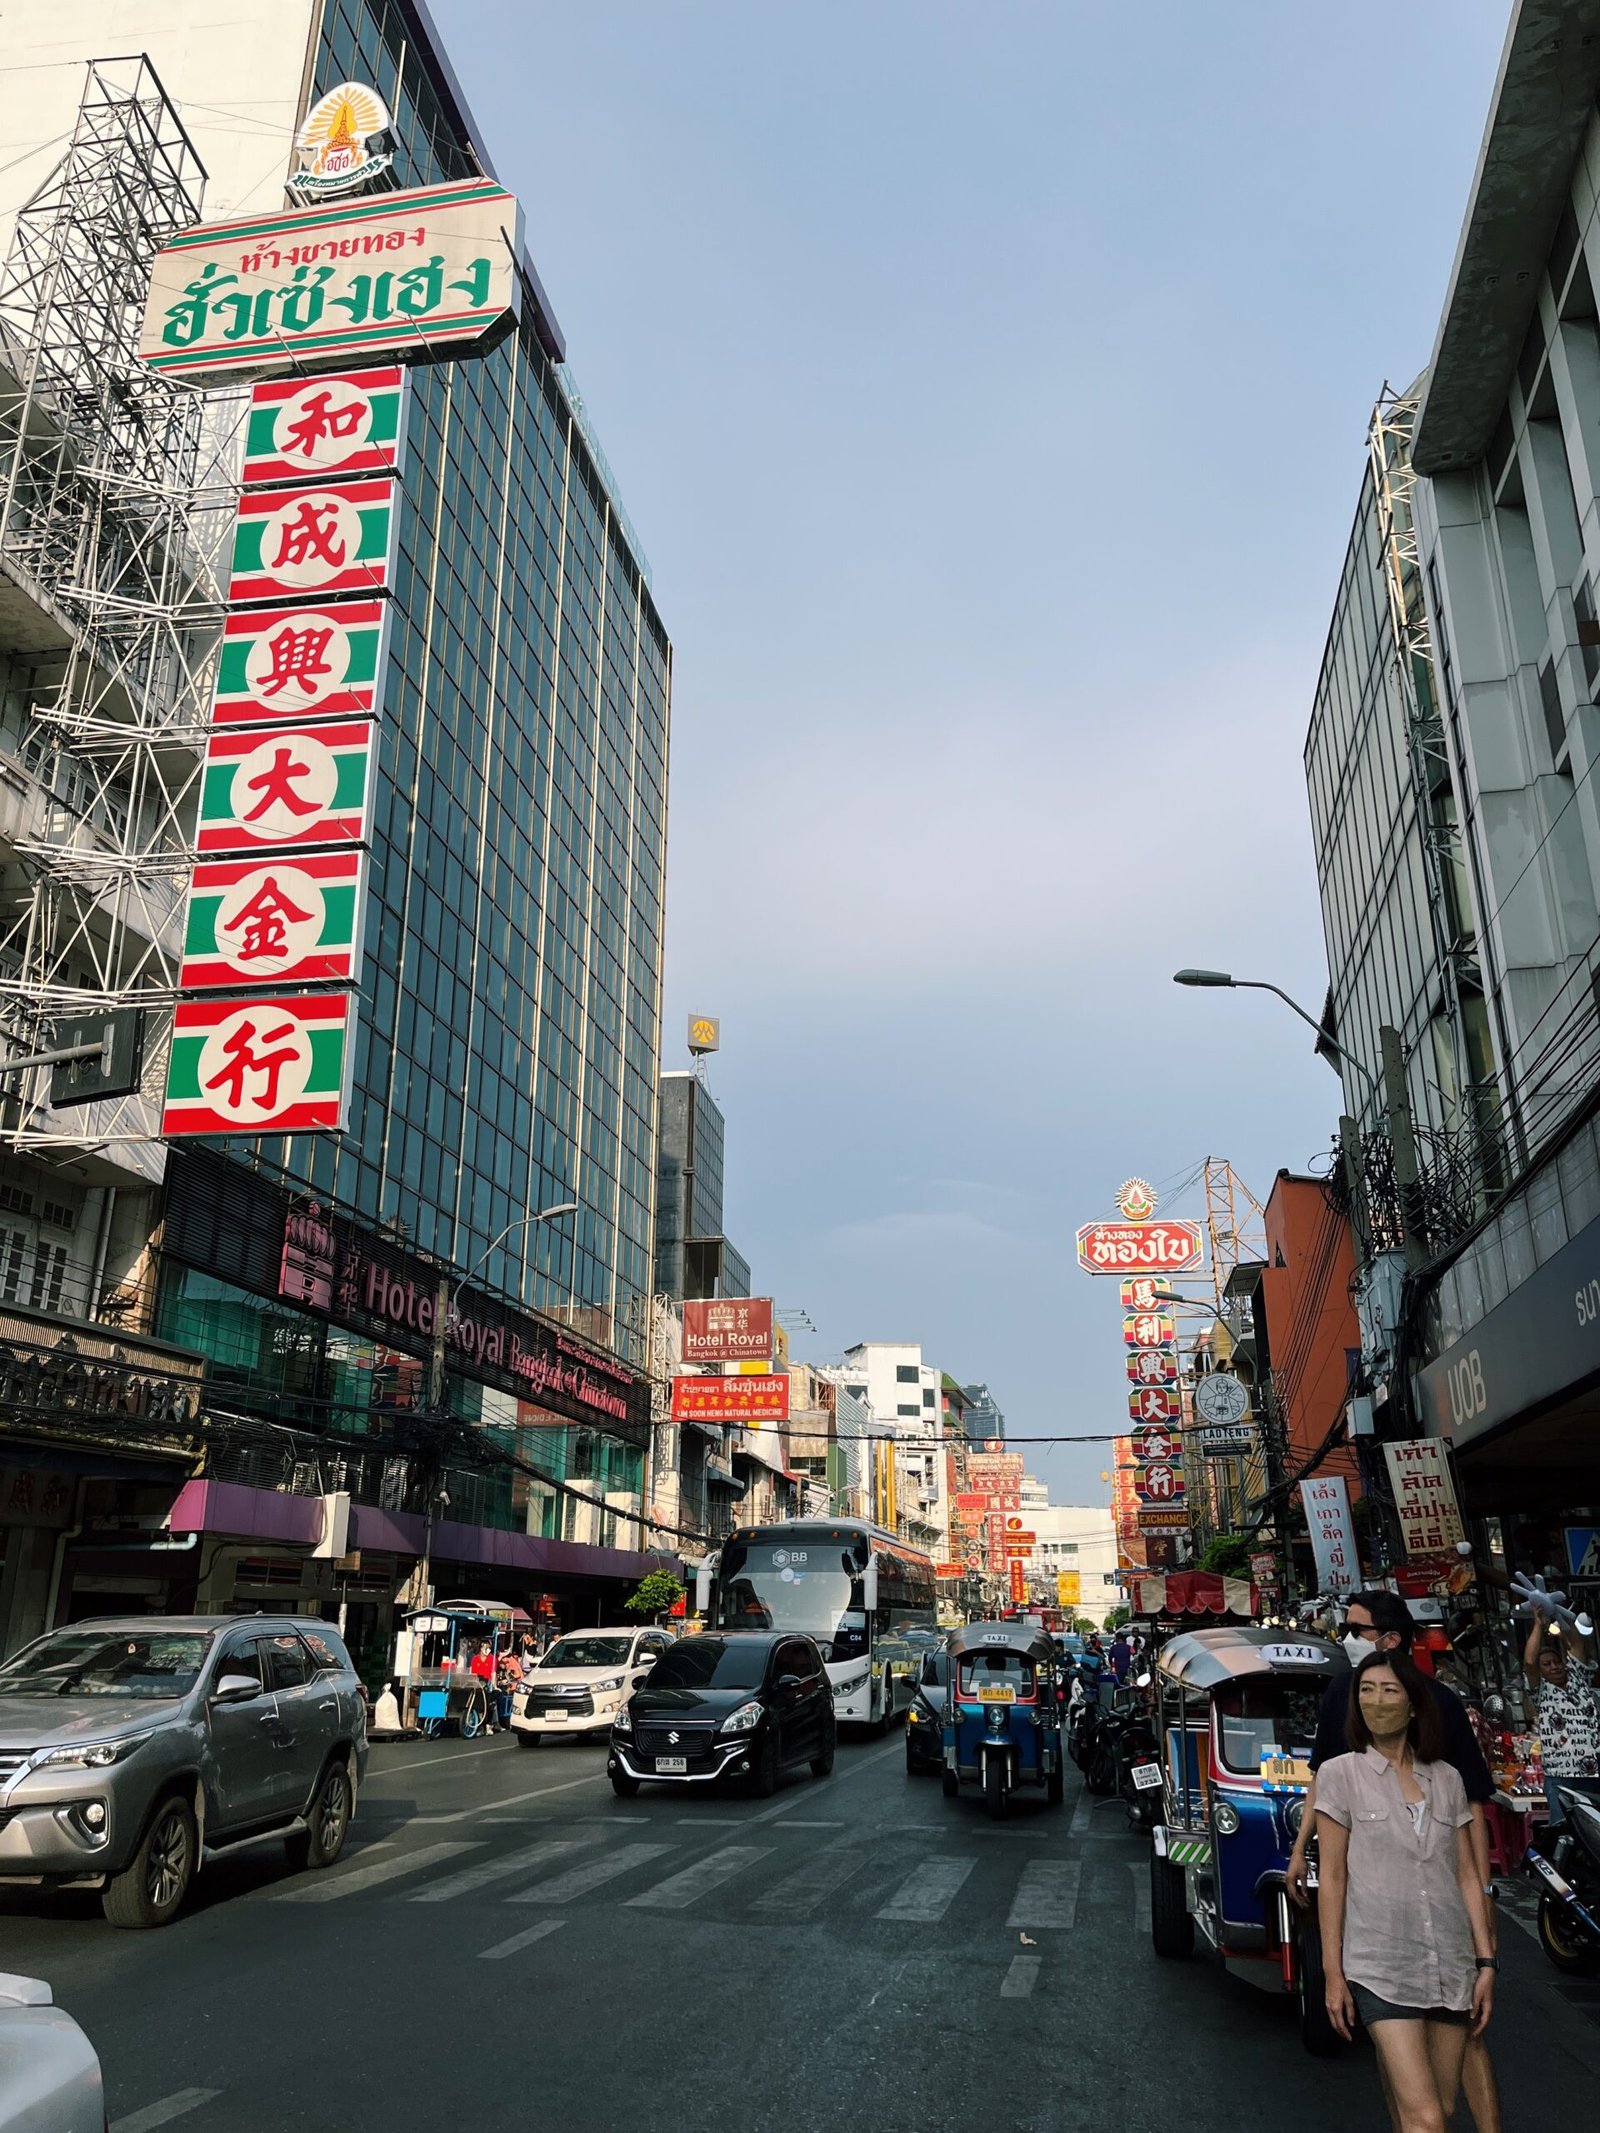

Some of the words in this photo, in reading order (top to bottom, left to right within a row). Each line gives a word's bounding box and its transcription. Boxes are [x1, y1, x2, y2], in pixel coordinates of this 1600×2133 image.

[241, 227, 425, 274] ห้างขายทอง
[162, 255, 492, 347] ฮั่วเซ่งเฮง
[205, 391, 367, 1110] 和成興大金行
[1094, 1227, 1144, 1241] ห้างทอง
[1091, 1229, 1190, 1263] ทองใบ
[364, 1260, 441, 1335] Hotel
[737, 1307, 749, 1330] 京华
[687, 1333, 723, 1346] Hotel
[728, 1332, 767, 1346] Royal
[687, 1350, 718, 1359] Bangkok
[1448, 1349, 1486, 1426] UOB
[707, 1409, 724, 1417] HENG
[725, 1409, 752, 1417] NATURAL
[753, 1408, 783, 1416] MEDICINE
[1202, 1428, 1250, 1439] LAOTENG
[1312, 1483, 1337, 1500] เล้ง
[1139, 1514, 1188, 1525] EXCHANGE
[1316, 1508, 1341, 1519] เกา
[791, 1552, 808, 1562] BB
[1328, 1570, 1351, 1590] ปุ่น
[1273, 1647, 1312, 1659] TAXI
